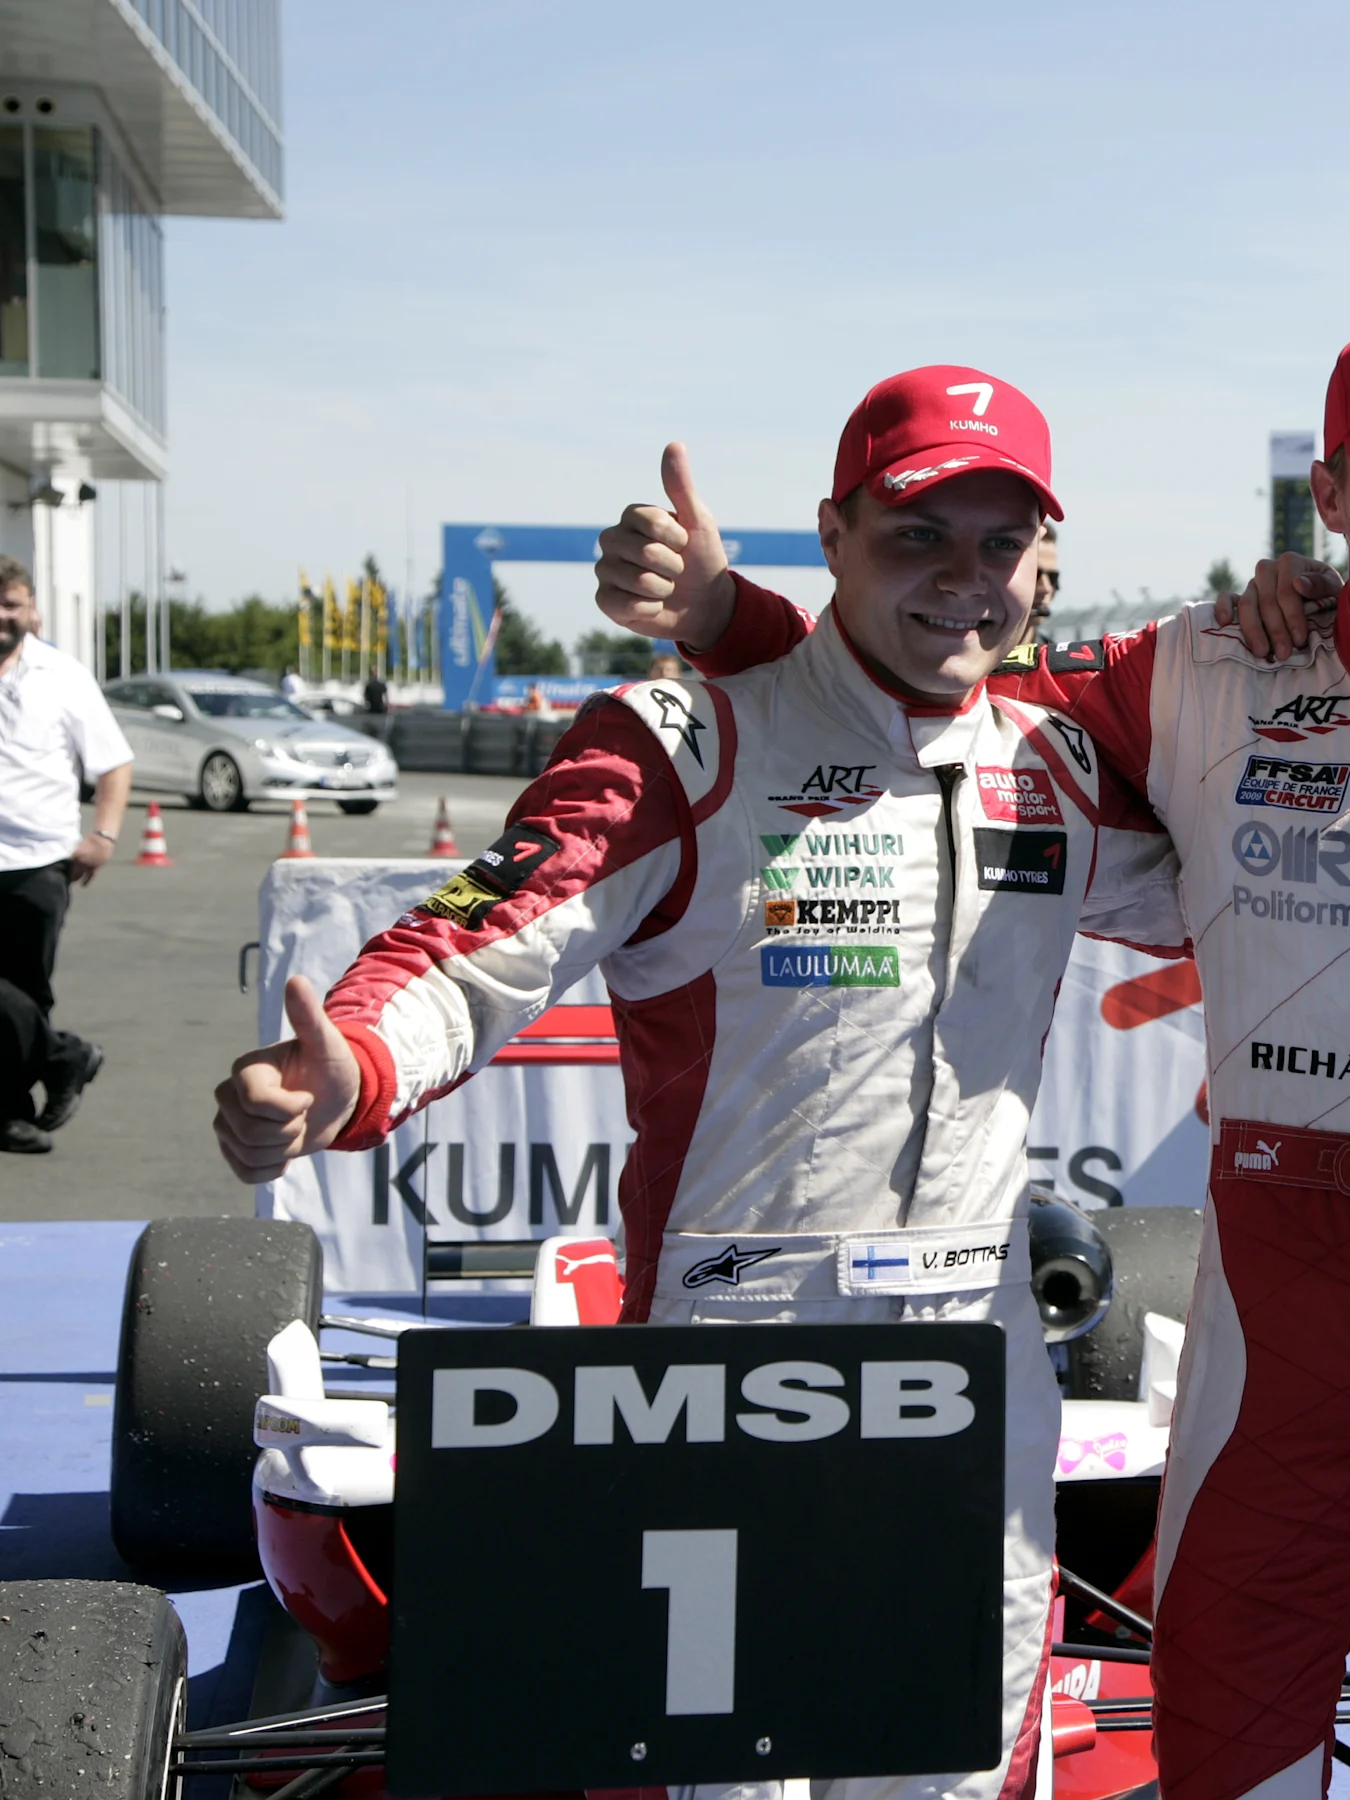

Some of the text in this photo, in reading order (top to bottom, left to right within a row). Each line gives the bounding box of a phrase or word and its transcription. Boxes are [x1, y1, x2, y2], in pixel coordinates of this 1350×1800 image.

[949, 420, 998, 436] KUMHO
[802, 765, 876, 793] ART
[979, 773, 1035, 791] auto
[1248, 758, 1336, 785] FFSA
[996, 789, 1047, 805] motor
[1283, 782, 1298, 792] DE
[1299, 784, 1342, 796] FRANCE
[1240, 790, 1339, 810] 2009 CIRCUIT
[1019, 804, 1058, 818] sport
[805, 834, 904, 856] WIHURI
[805, 866, 895, 888] WIPAK
[984, 866, 1049, 883] KUMHO TYRES
[797, 900, 899, 924] KEMPPI
[1234, 1152, 1271, 1171] PUMA
[922, 1243, 1011, 1269] V. BOTTAS
[432, 1360, 976, 1448] DMSB
[641, 1529, 738, 1716] 1
